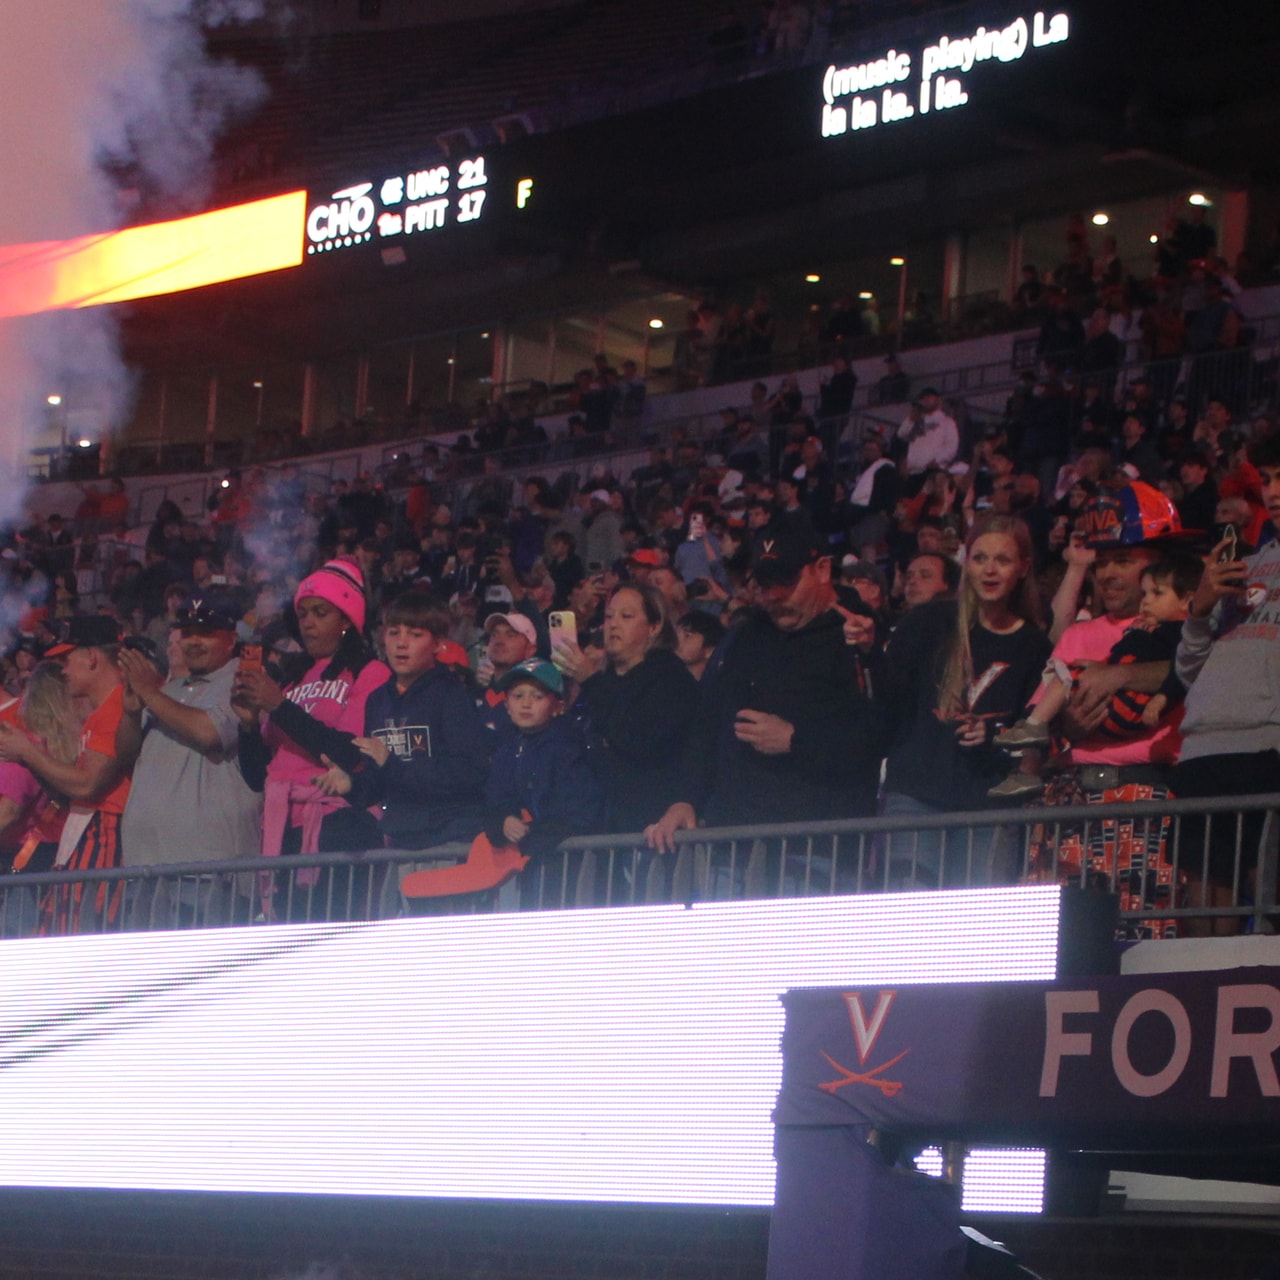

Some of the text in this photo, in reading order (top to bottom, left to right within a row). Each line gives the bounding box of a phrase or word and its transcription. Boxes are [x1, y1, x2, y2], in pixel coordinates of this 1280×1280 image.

[823, 11, 1069, 105] (music playing) La
[822, 103, 847, 137] la
[851, 96, 877, 130] la
[882, 89, 914, 123] la.
[935, 76, 969, 110] la.
[406, 166, 450, 200] UNC
[457, 156, 488, 190] 21
[516, 178, 534, 209] F
[306, 197, 375, 242] CHO
[404, 198, 450, 234] PITT
[456, 190, 487, 223] 17
